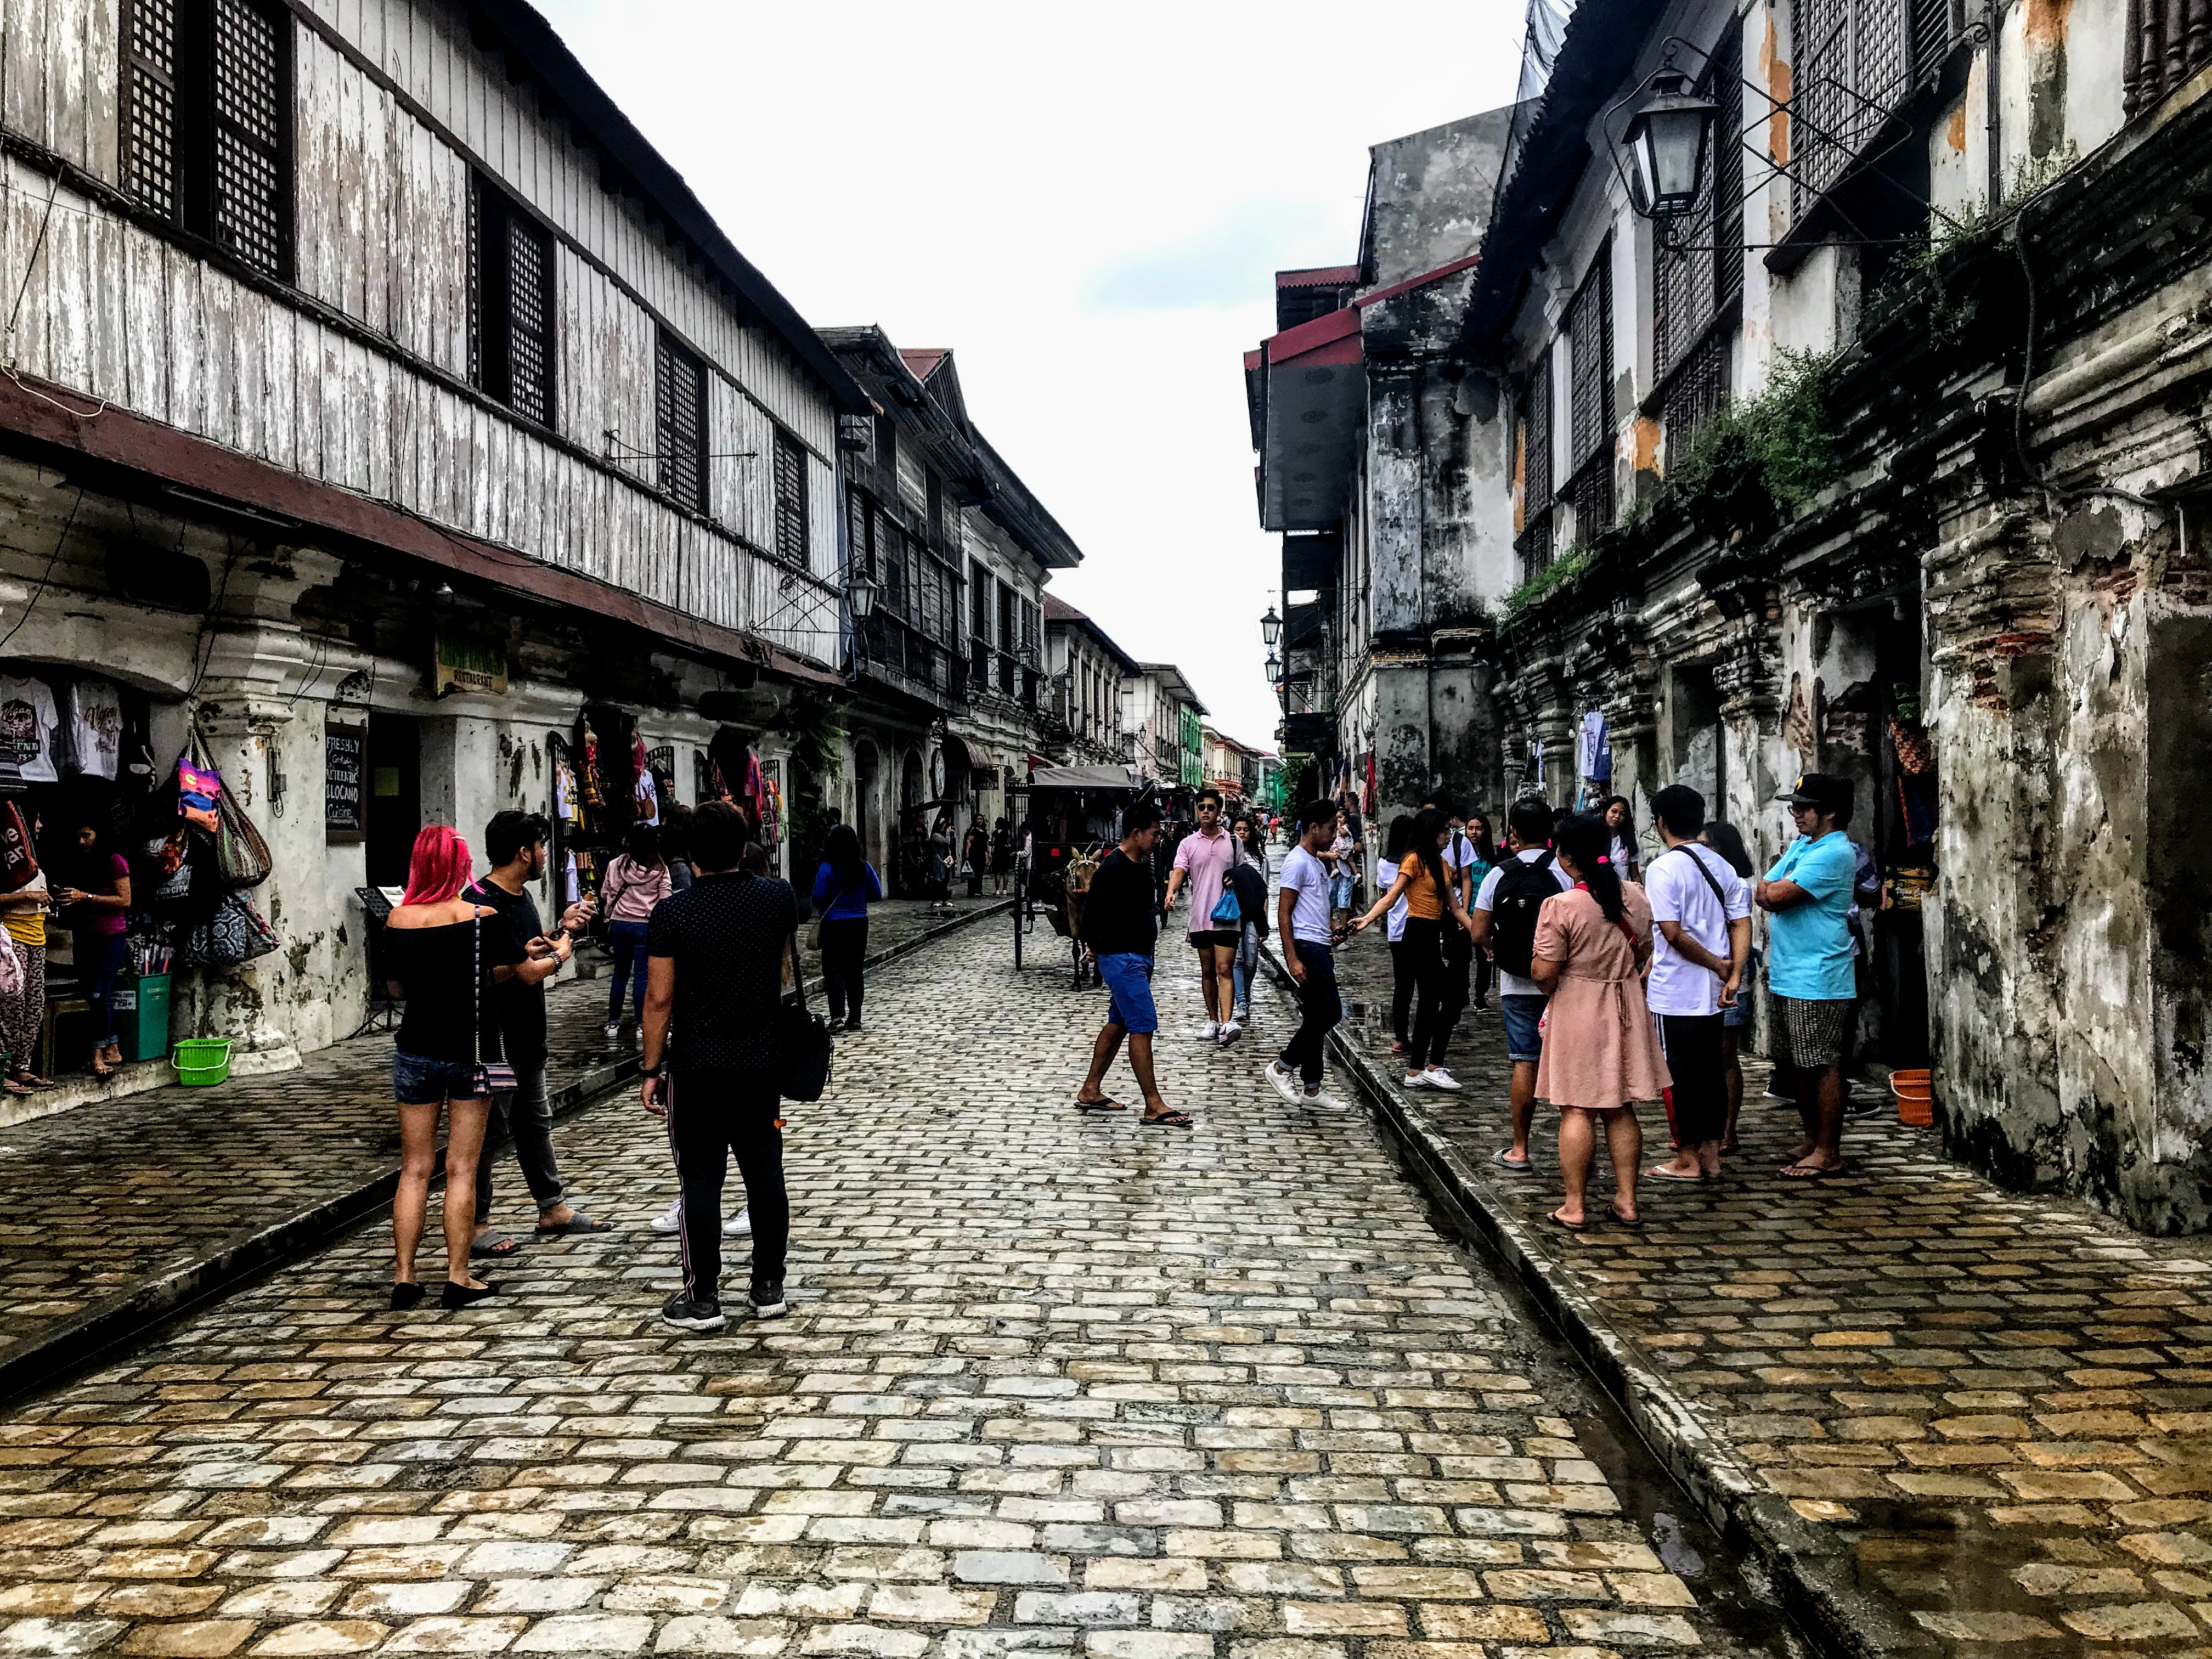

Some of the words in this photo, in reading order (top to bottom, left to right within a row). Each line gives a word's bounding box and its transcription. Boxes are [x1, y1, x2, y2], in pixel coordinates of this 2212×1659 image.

[453, 669, 493, 688] RESTAURANT
[326, 736, 359, 754] FRESHLY
[326, 783, 358, 803] ILOCANO
